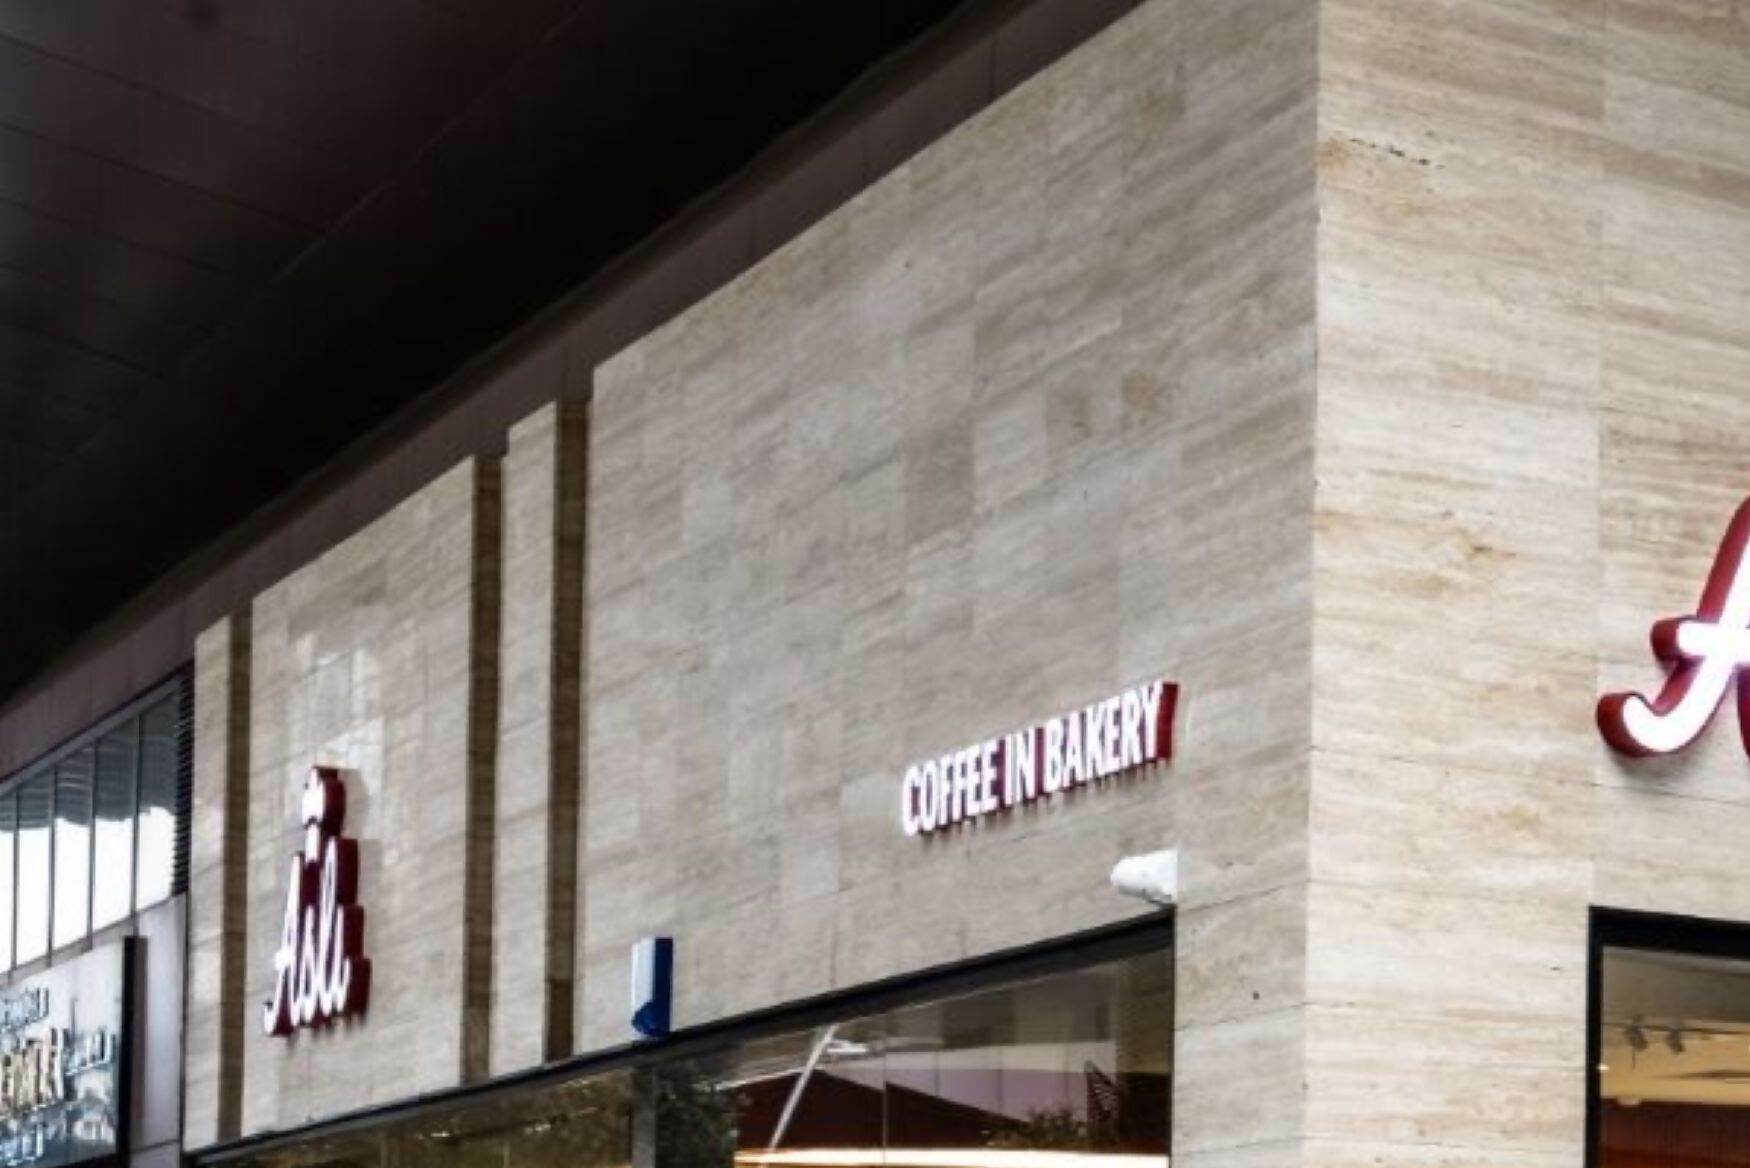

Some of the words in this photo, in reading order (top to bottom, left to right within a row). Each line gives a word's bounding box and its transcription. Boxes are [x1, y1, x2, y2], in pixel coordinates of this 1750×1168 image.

[902, 738, 1000, 837] COFFEE
[1003, 727, 1037, 806] IN
[1042, 679, 1169, 793] BAKERY
